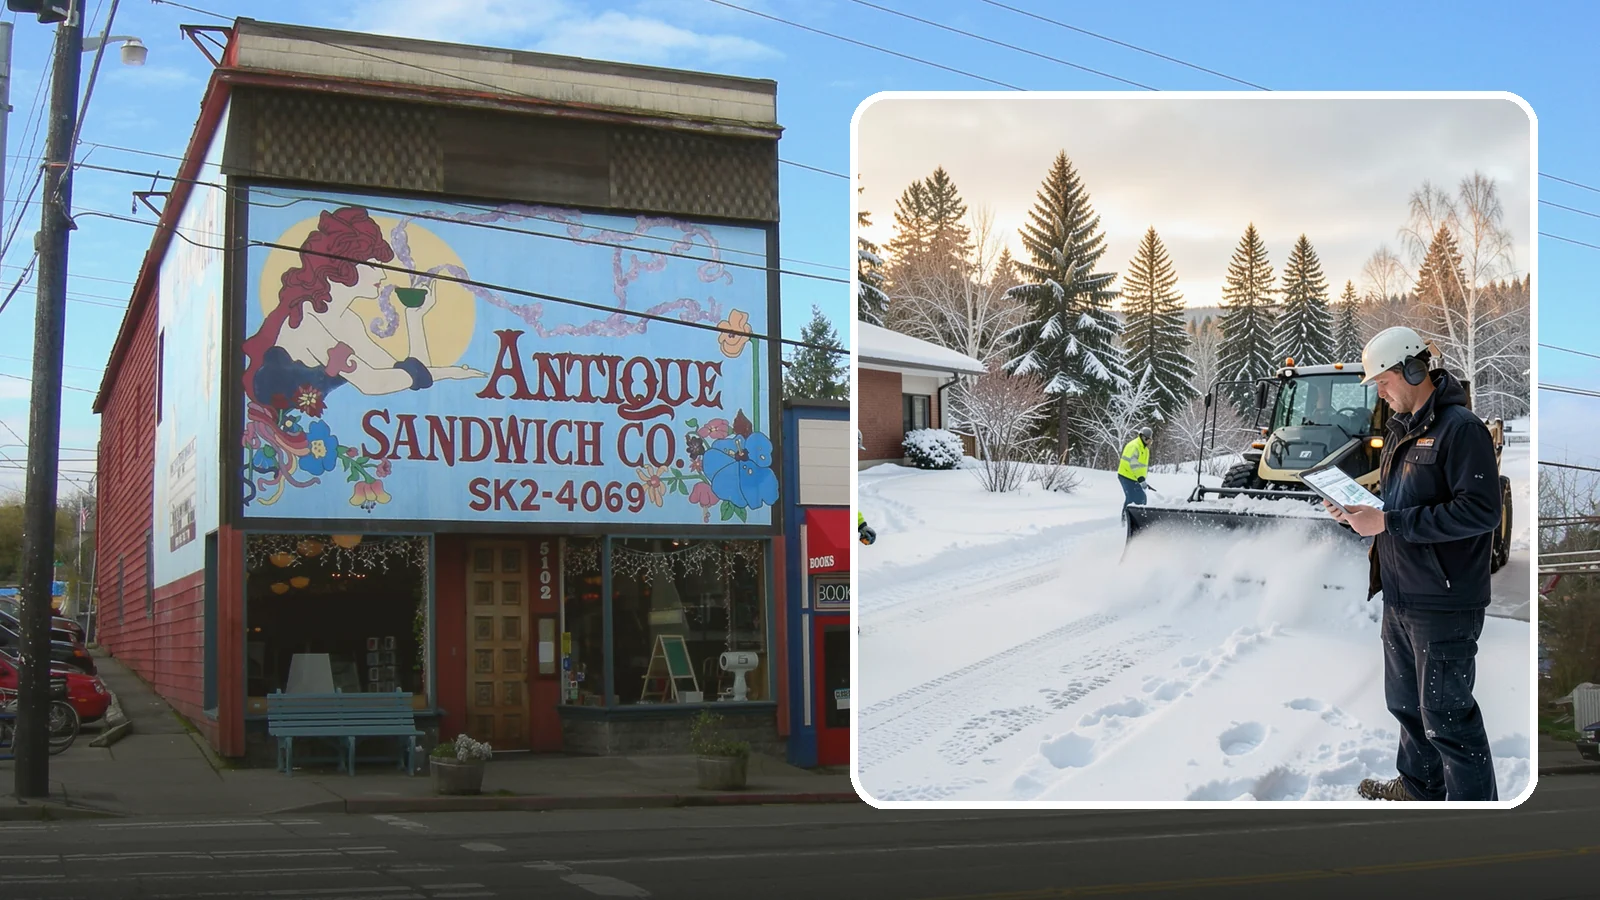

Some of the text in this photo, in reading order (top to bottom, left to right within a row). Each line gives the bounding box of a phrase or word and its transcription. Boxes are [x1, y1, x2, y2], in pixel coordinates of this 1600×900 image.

[476, 329, 723, 421] ANTIQUE
[361, 408, 685, 469] SANDWICH CO.
[468, 477, 645, 514] SK2-4069
[540, 541, 551, 600] 5102
[810, 555, 835, 568] BOOKS
